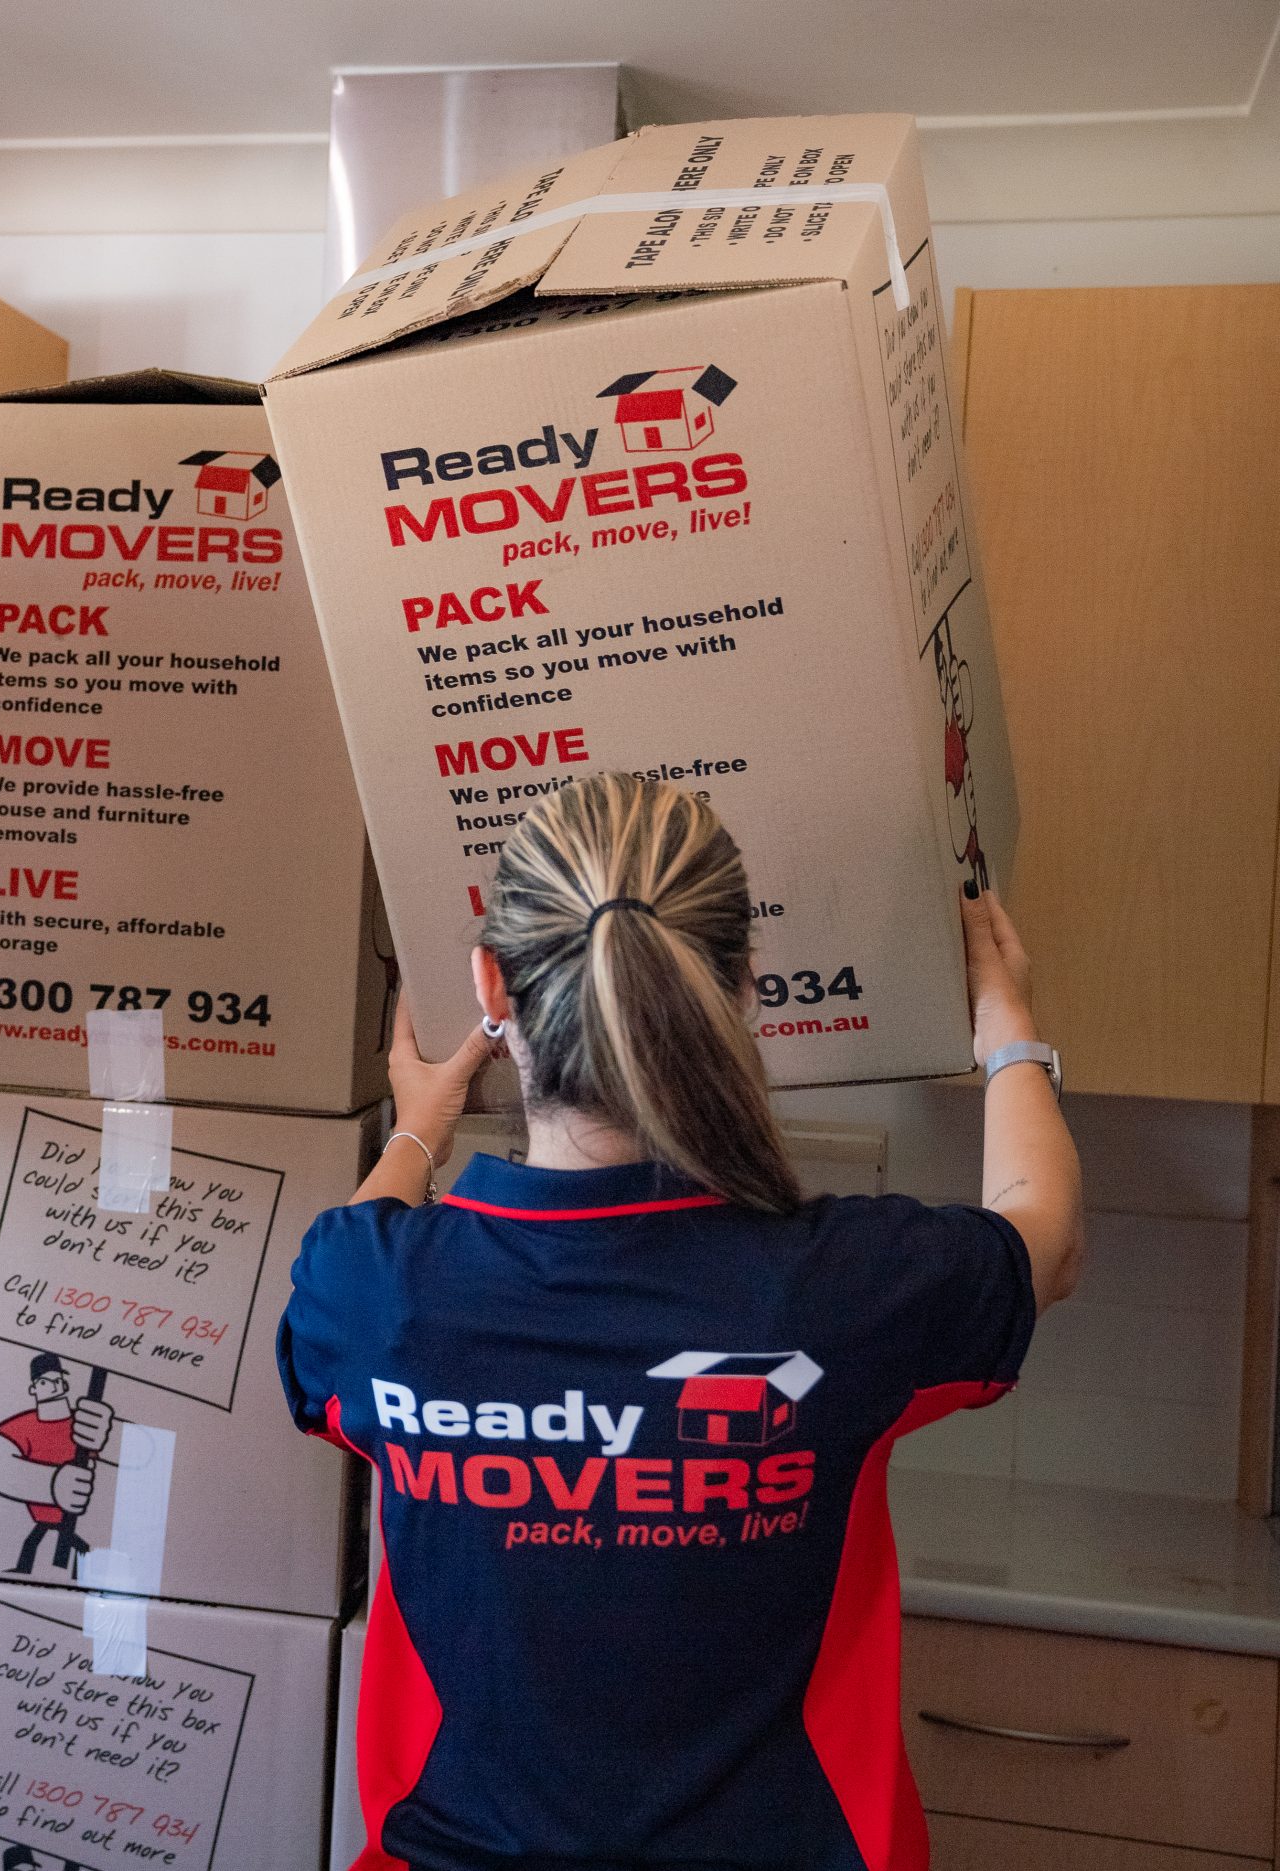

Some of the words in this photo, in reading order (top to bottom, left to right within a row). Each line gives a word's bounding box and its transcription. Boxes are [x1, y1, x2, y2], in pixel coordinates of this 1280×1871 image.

[625, 240, 666, 269] TAPE
[646, 208, 684, 236] ALON
[688, 136, 724, 163] ONLY
[380, 425, 599, 491] Ready
[2, 478, 174, 519] Ready
[384, 453, 748, 548] MOVERS
[1, 523, 283, 563] MOVERS
[503, 535, 581, 567] pack,
[591, 520, 682, 550] move,
[690, 502, 753, 534] live!
[83, 570, 145, 592] pack,
[153, 572, 221, 593] move,
[230, 571, 280, 591] live!
[402, 580, 549, 633] PACK
[417, 643, 458, 664] We
[465, 635, 528, 661] pack
[537, 628, 567, 649] all
[576, 620, 634, 649] your
[642, 597, 784, 634] household
[28, 649, 79, 669] pack
[85, 651, 110, 666] all
[117, 653, 163, 672] your
[169, 653, 280, 672] household
[424, 665, 497, 691] items
[504, 662, 534, 681] so
[542, 657, 590, 681] you
[597, 646, 667, 670] move
[674, 633, 737, 660] with
[54, 676, 78, 691] so
[85, 676, 121, 696] you
[128, 679, 184, 694] move
[190, 678, 238, 695] with
[431, 685, 572, 718] confidence
[434, 727, 589, 777] MOVE
[23, 779, 99, 800] provide
[106, 782, 224, 802] hassle-free
[450, 787, 488, 805] We
[497, 776, 573, 805] provid
[599, 758, 748, 782] ssle-free
[53, 804, 90, 820] and
[97, 805, 190, 825] furniture
[33, 913, 109, 935] secure,
[117, 917, 225, 939] affordable
[187, 991, 271, 1026] 934
[757, 966, 863, 1007] 934
[46, 1204, 96, 1229] with
[105, 1219, 133, 1234] us
[140, 1221, 168, 1246] if
[44, 1231, 107, 1261] don't
[114, 1251, 168, 1271] need
[175, 1259, 209, 1284] it?
[4, 1275, 48, 1303] Call
[54, 1287, 111, 1312] 1300
[122, 1300, 173, 1328] 787
[181, 1316, 229, 1345] 934
[371, 1378, 644, 1456] Ready
[386, 1443, 816, 1513] MOVERS
[505, 1517, 602, 1550] pack,
[616, 1521, 726, 1548] move,
[741, 1502, 807, 1542] live!
[17, 1698, 68, 1723] with
[76, 1714, 104, 1730] us
[112, 1718, 140, 1743] if
[15, 1724, 78, 1755] don't
[85, 1747, 140, 1767] need
[147, 1757, 180, 1783] it?
[25, 1779, 83, 1808] 1300
[94, 1797, 144, 1824] 787
[153, 1814, 200, 1845] 934
